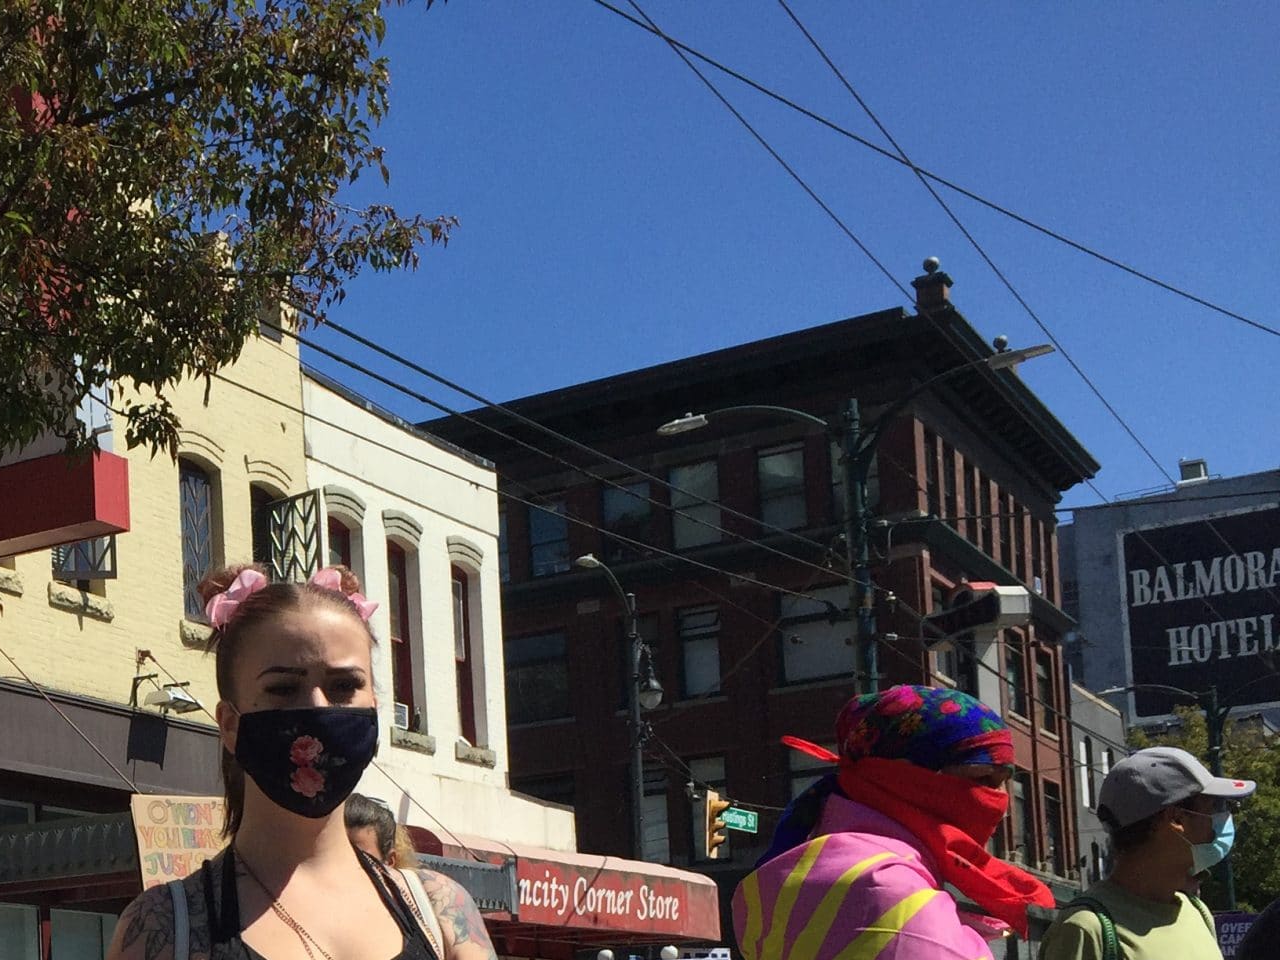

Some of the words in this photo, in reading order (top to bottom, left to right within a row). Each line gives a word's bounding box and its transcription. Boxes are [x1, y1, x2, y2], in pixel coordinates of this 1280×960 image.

[1166, 614, 1280, 666] HOTEL
[144, 852, 193, 877] JUST
[573, 876, 634, 916] Corner
[636, 885, 680, 921] Store
